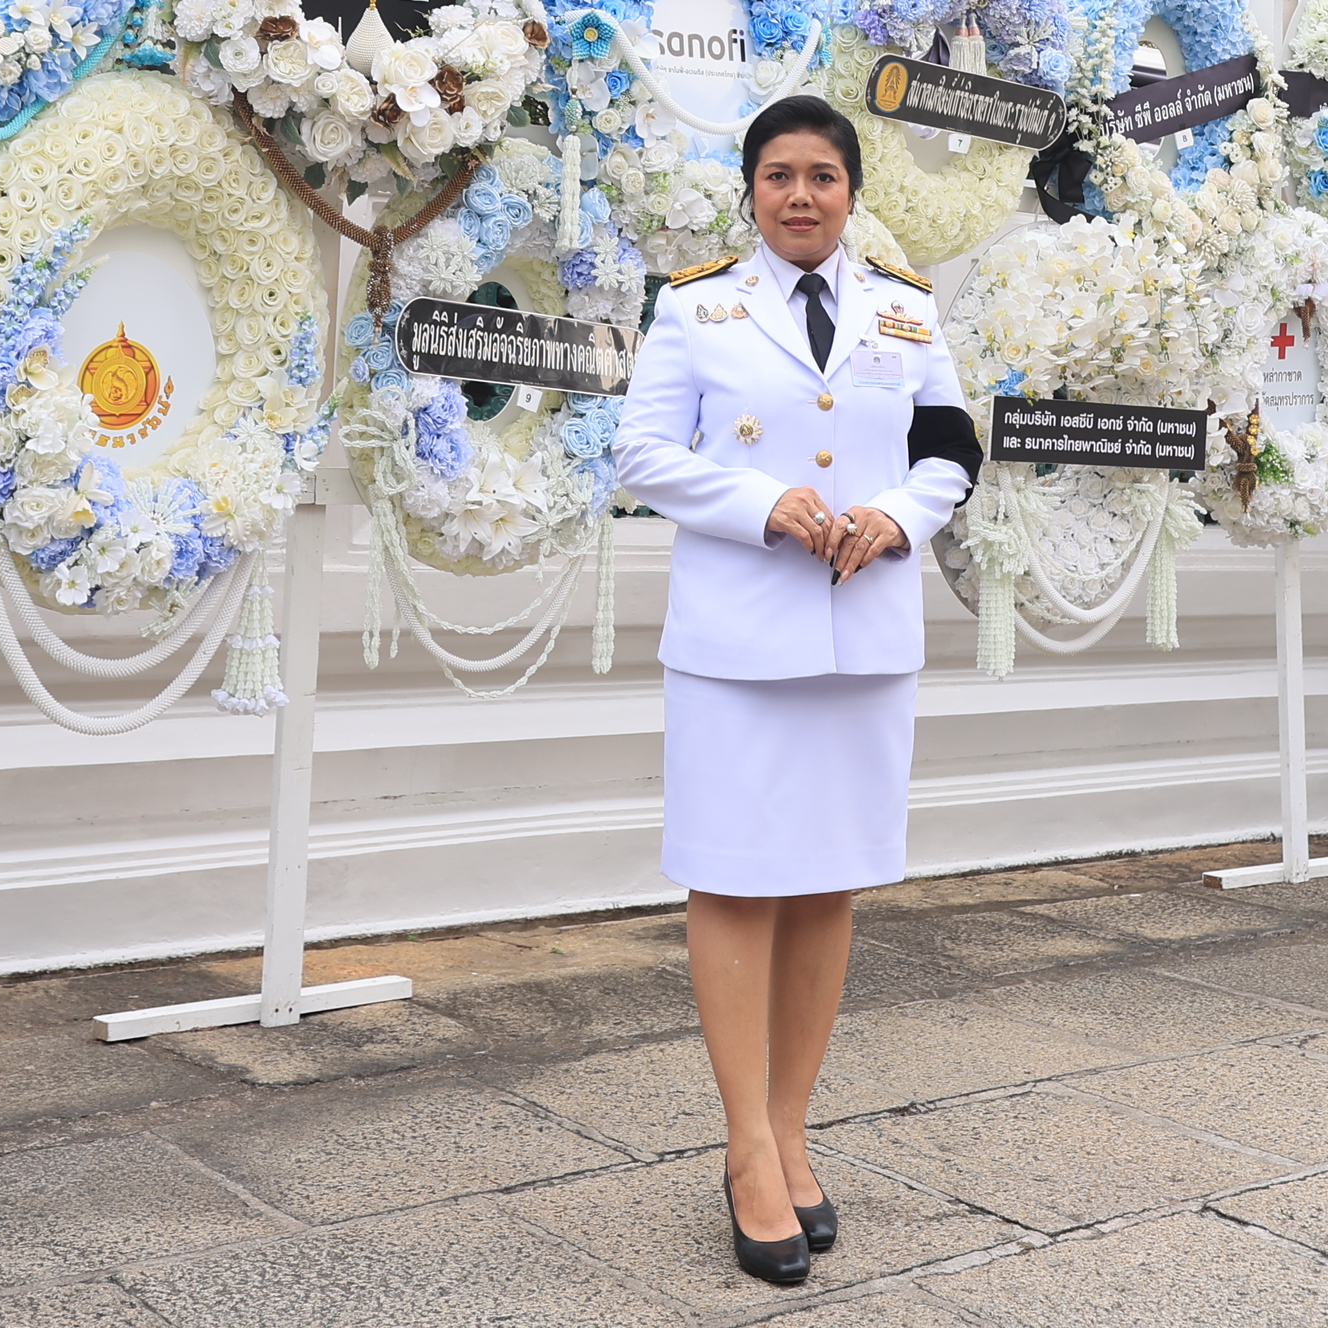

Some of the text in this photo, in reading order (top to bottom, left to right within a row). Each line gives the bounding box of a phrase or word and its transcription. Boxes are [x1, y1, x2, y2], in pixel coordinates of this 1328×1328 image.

[1100, 73, 1254, 137] บริษัท ซีพี ออลล์ จำกัด (มหาชน)
[957, 139, 963, 147] 7
[1182, 134, 1188, 143] 8
[525, 393, 532, 403] 9
[1004, 408, 1197, 438] กลุ่มบริษัท เอสซีบี เอกซ์ จำกัด (มหาชน)
[1003, 434, 1195, 461] และ ธนาคารไทยพาณิชย์ จำกัด (มหาชน)
